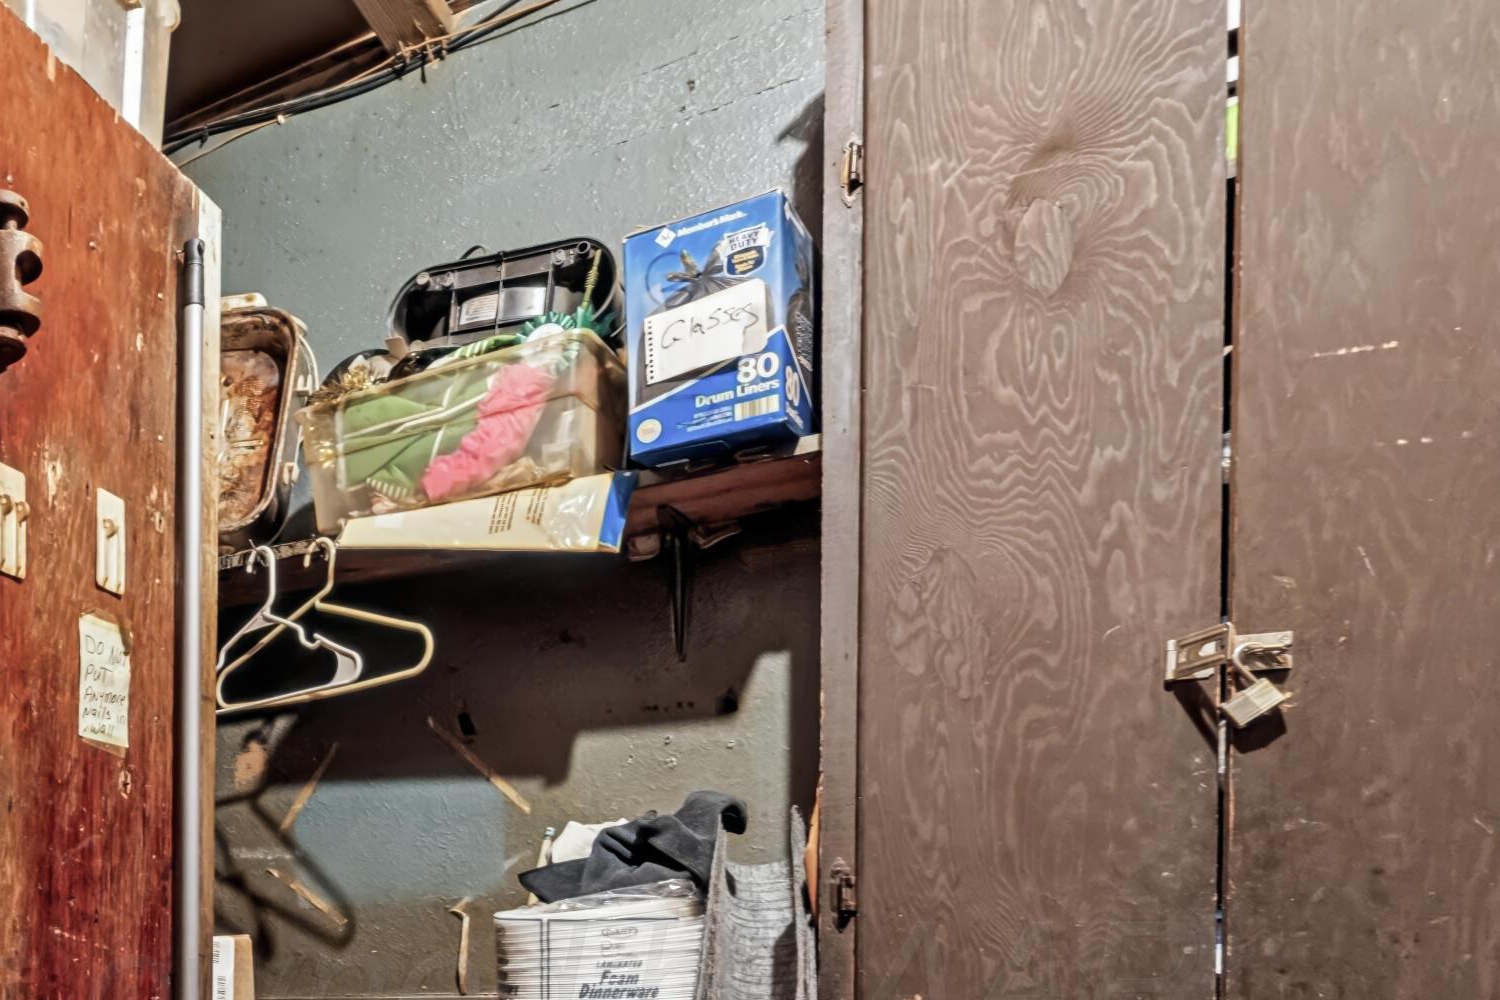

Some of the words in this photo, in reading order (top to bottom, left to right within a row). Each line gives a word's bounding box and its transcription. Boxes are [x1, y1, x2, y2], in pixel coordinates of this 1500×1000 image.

[729, 230, 759, 244] HEAVY
[731, 238, 757, 251] DUTY
[737, 352, 779, 383] 80
[695, 391, 734, 408] Drum
[737, 379, 780, 397] Liners
[600, 970, 639, 985] Foam
[579, 983, 659, 999] Dinnerware
